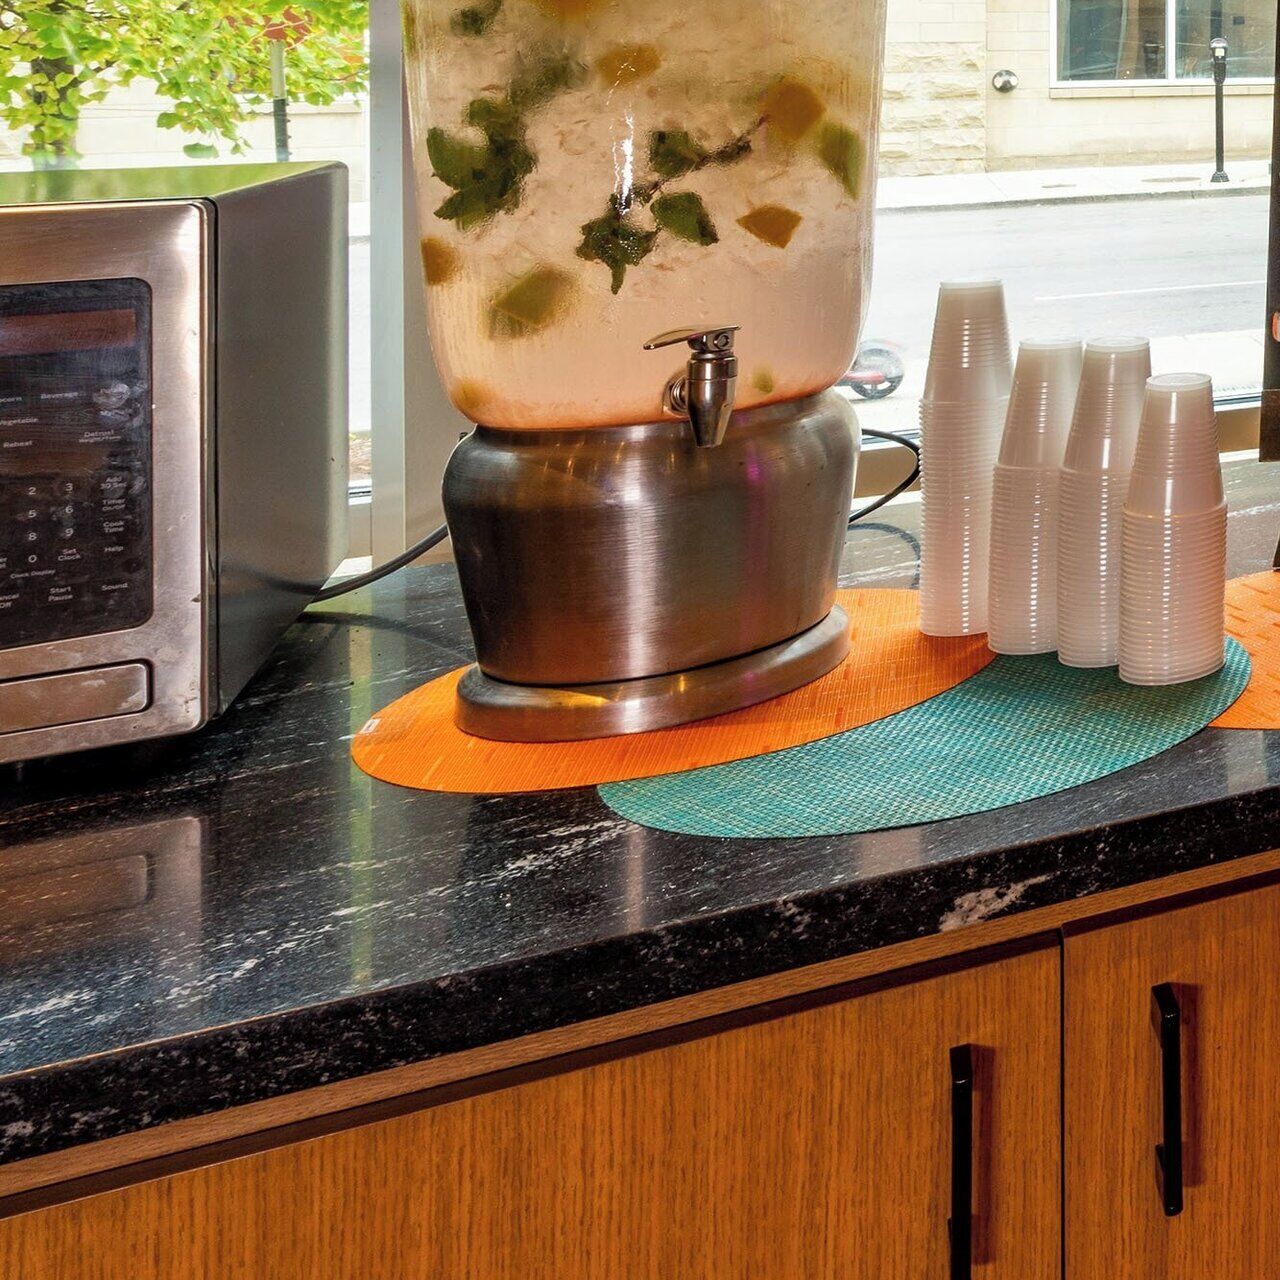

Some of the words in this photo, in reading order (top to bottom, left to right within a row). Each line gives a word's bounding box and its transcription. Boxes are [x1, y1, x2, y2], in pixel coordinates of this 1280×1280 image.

[27, 486, 37, 495] 2
[65, 482, 74, 492] 3
[27, 509, 37, 518] 5
[65, 505, 74, 514] 6
[27, 532, 37, 541] 8
[65, 527, 74, 537] 9
[50, 586, 72, 594] Start
[102, 583, 128, 591] Sound
[48, 594, 74, 602] Pause
